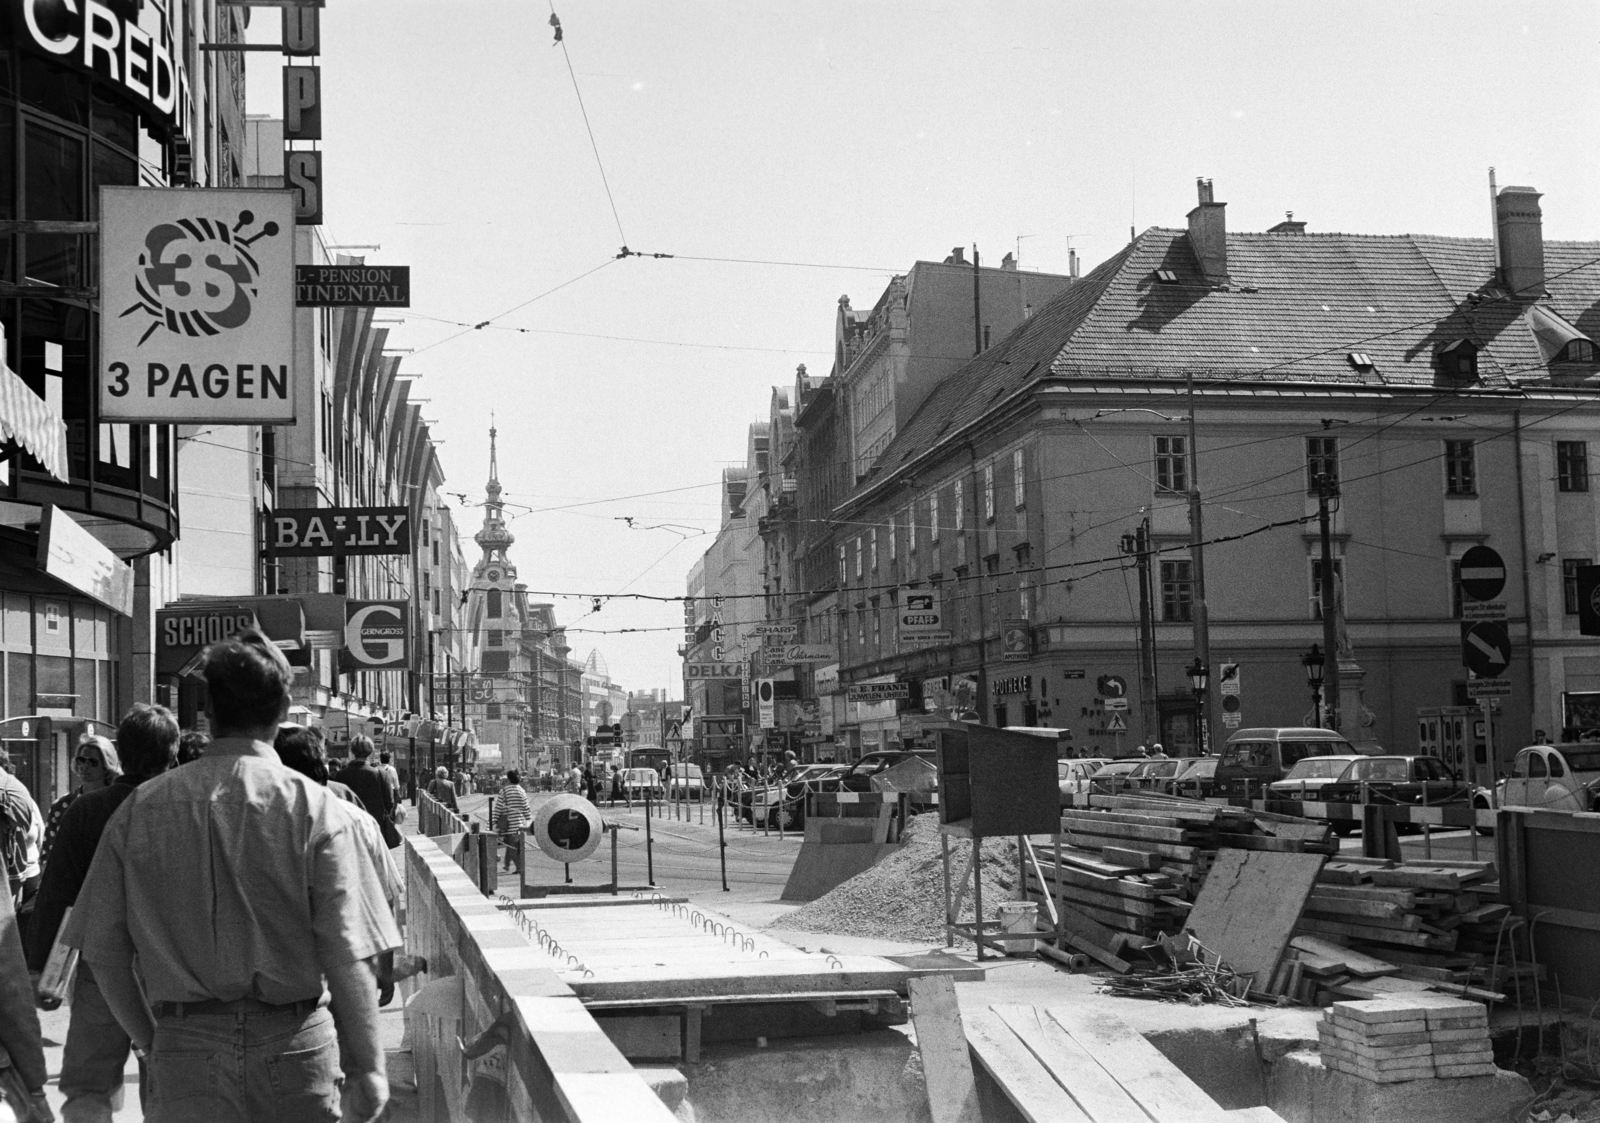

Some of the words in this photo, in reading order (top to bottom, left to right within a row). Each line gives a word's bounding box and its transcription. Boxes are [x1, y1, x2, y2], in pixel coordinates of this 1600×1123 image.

[319, 268, 392, 283] PENSION
[107, 361, 130, 397] 3
[147, 363, 288, 400] PAGEN
[907, 615, 935, 625] PFAFF
[361, 627, 404, 636] GERNGROSS
[756, 626, 796, 634] SHARP
[871, 683, 908, 692] FRANK
[992, 675, 1028, 696] APOTHEKE
[884, 691, 908, 699] UHREN
